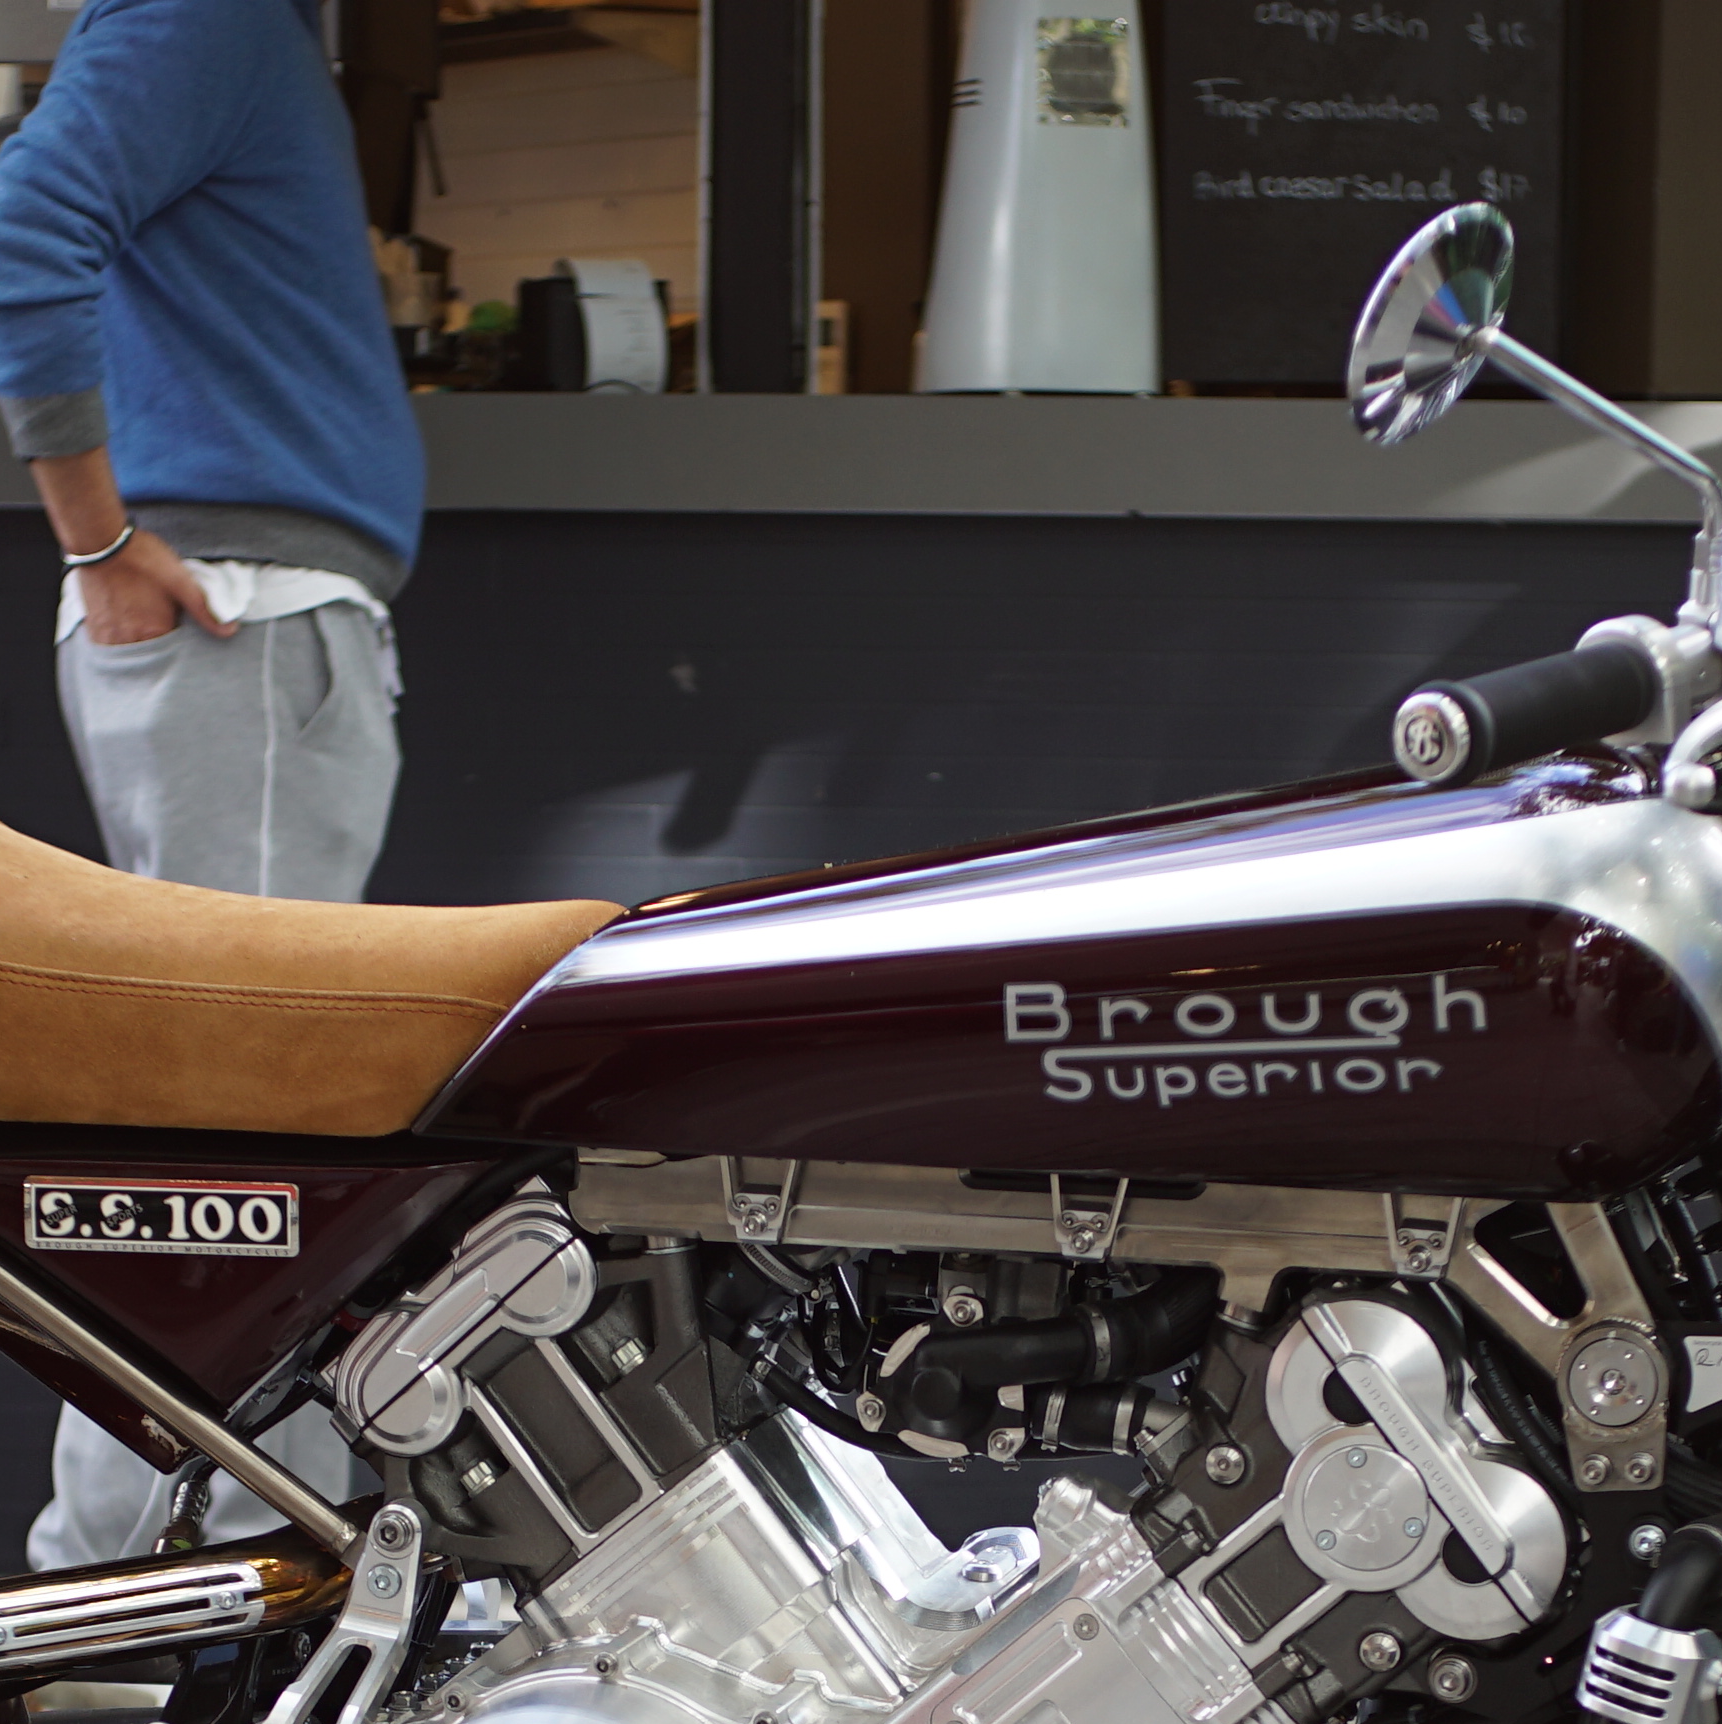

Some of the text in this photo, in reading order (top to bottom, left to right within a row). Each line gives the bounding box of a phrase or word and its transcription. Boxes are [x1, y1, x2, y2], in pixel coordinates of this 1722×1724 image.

[1003, 974, 1488, 1043] Brough
[1041, 1042, 1443, 1108] Superior
[39, 1190, 283, 1243] S.S.100
[45, 1203, 79, 1226] SUPER
[105, 1202, 144, 1228] SPORTS
